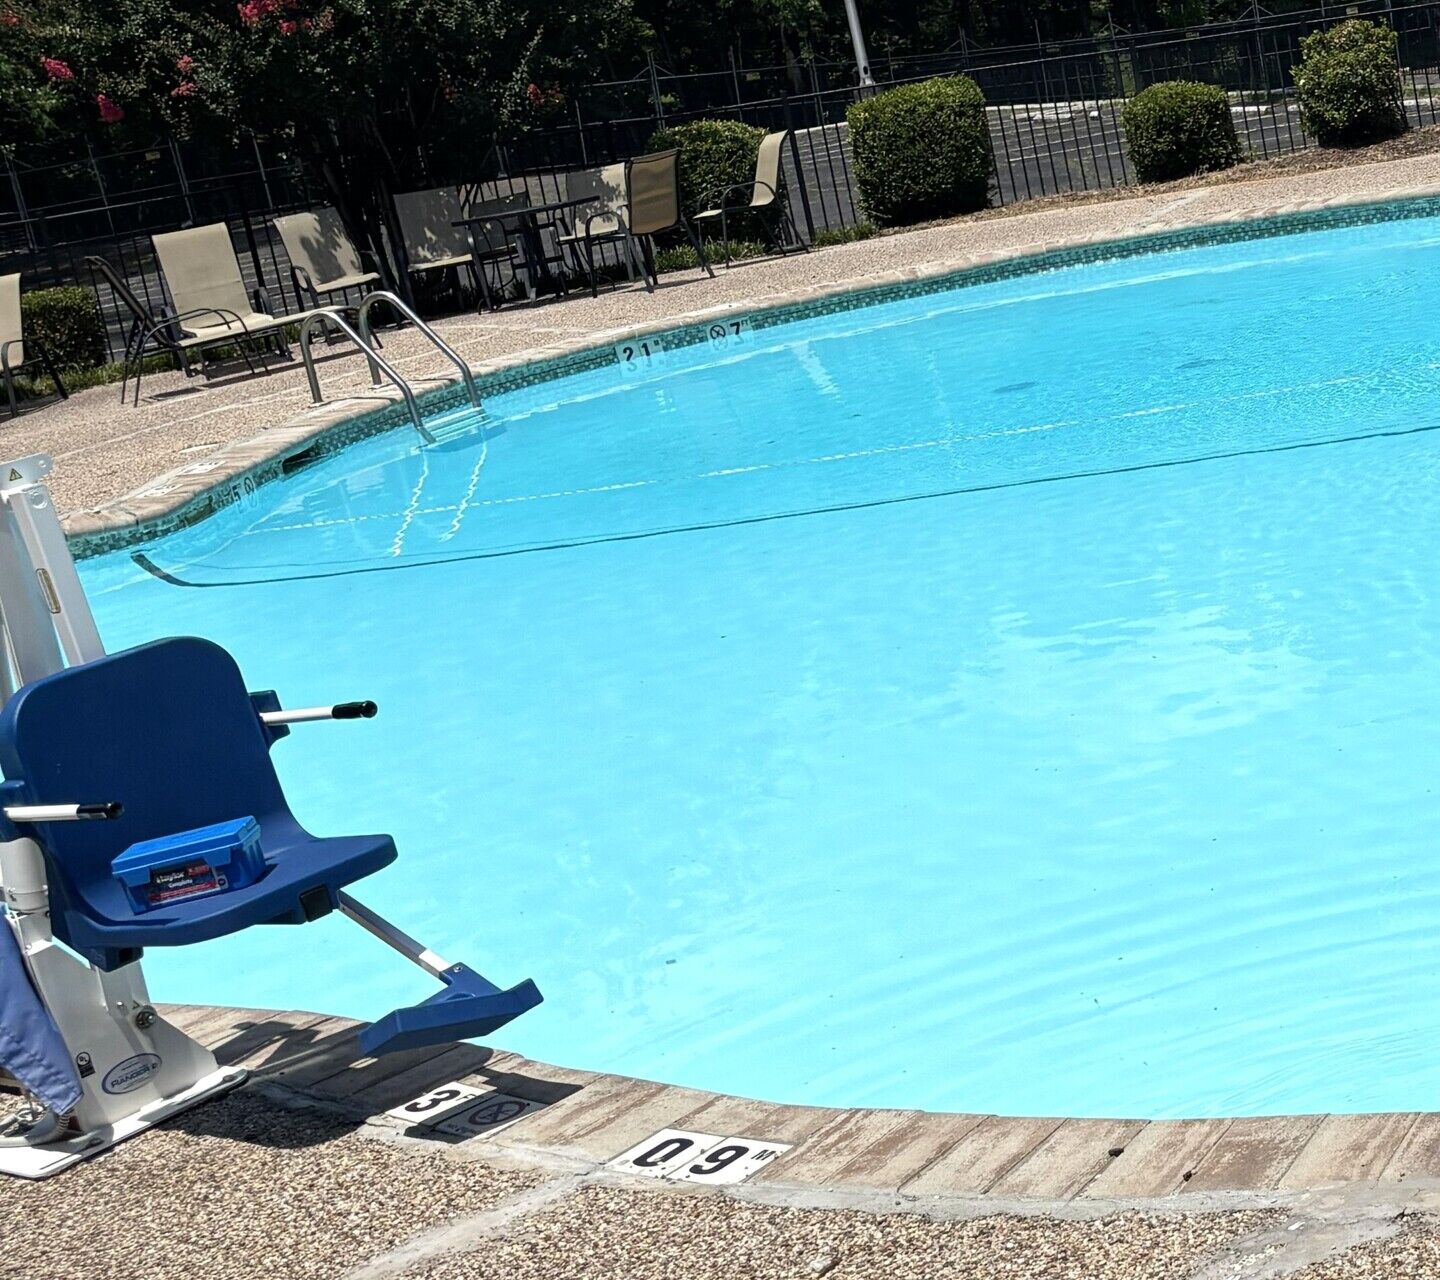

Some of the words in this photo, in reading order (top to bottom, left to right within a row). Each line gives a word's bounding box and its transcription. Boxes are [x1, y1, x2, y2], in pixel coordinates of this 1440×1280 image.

[729, 321, 741, 336] 7
[404, 1089, 462, 1113] 3
[750, 1149, 777, 1161] M
